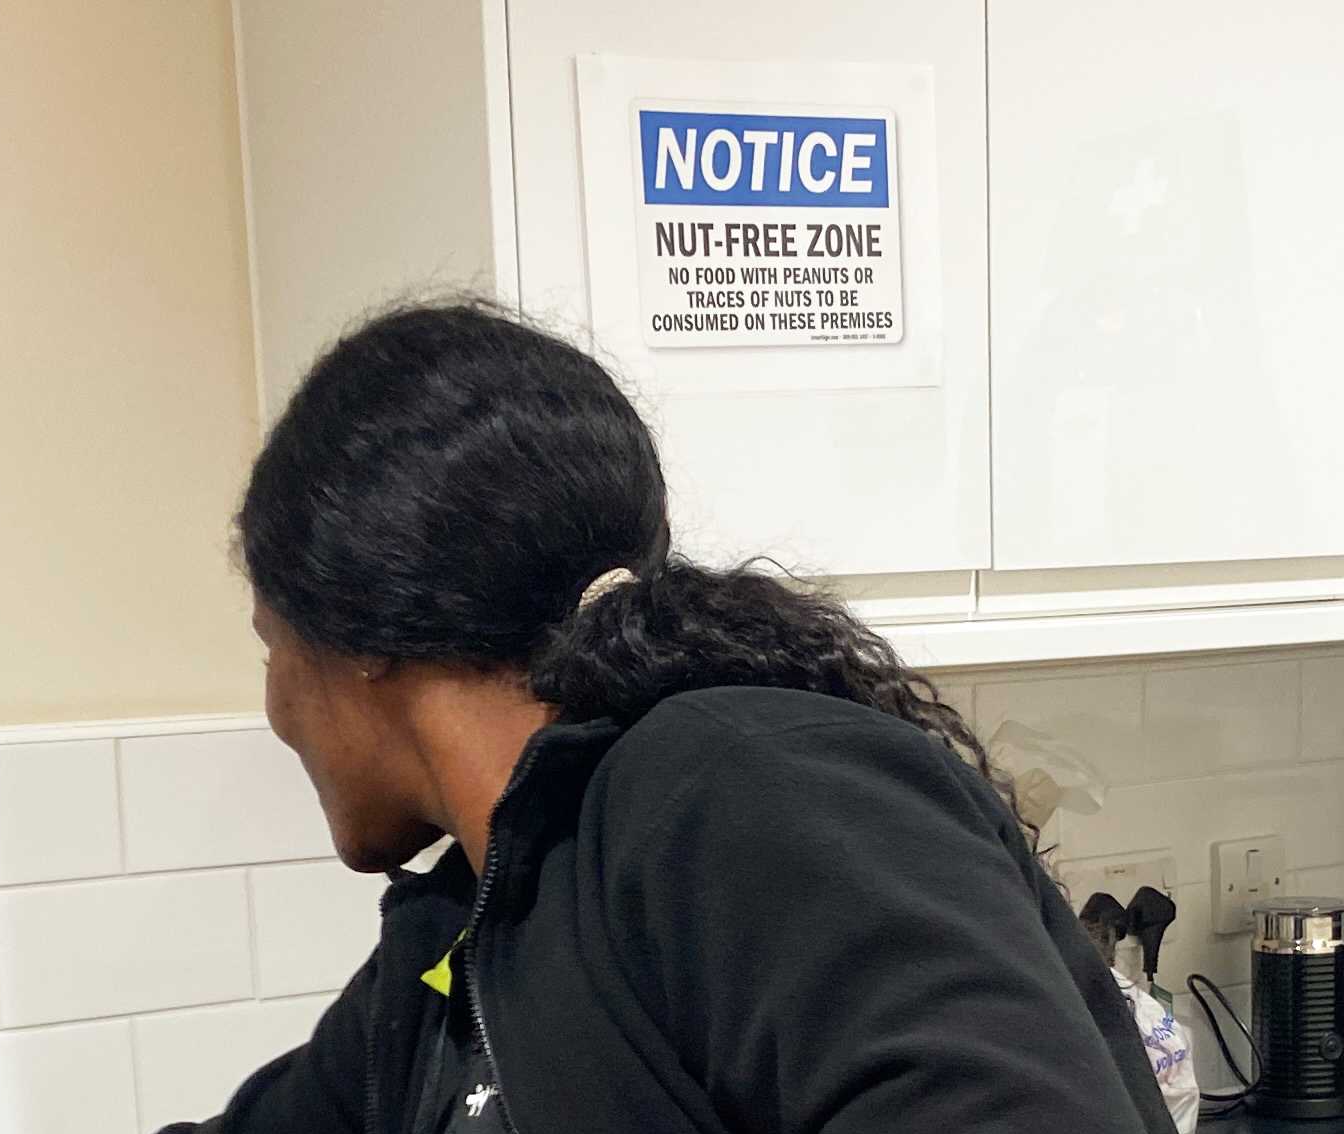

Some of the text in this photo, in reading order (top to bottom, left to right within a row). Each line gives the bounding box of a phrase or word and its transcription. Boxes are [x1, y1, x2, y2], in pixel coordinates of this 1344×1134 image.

[655, 127, 877, 193] NOTICE
[655, 222, 883, 258] NUT-FREE ZONE
[668, 267, 874, 285] NO FOOD WITH PEANUTS OR
[686, 290, 859, 308] TRACES OF NUTS TO BE
[652, 311, 894, 332] CONSUMED ON THESE PREMISES
